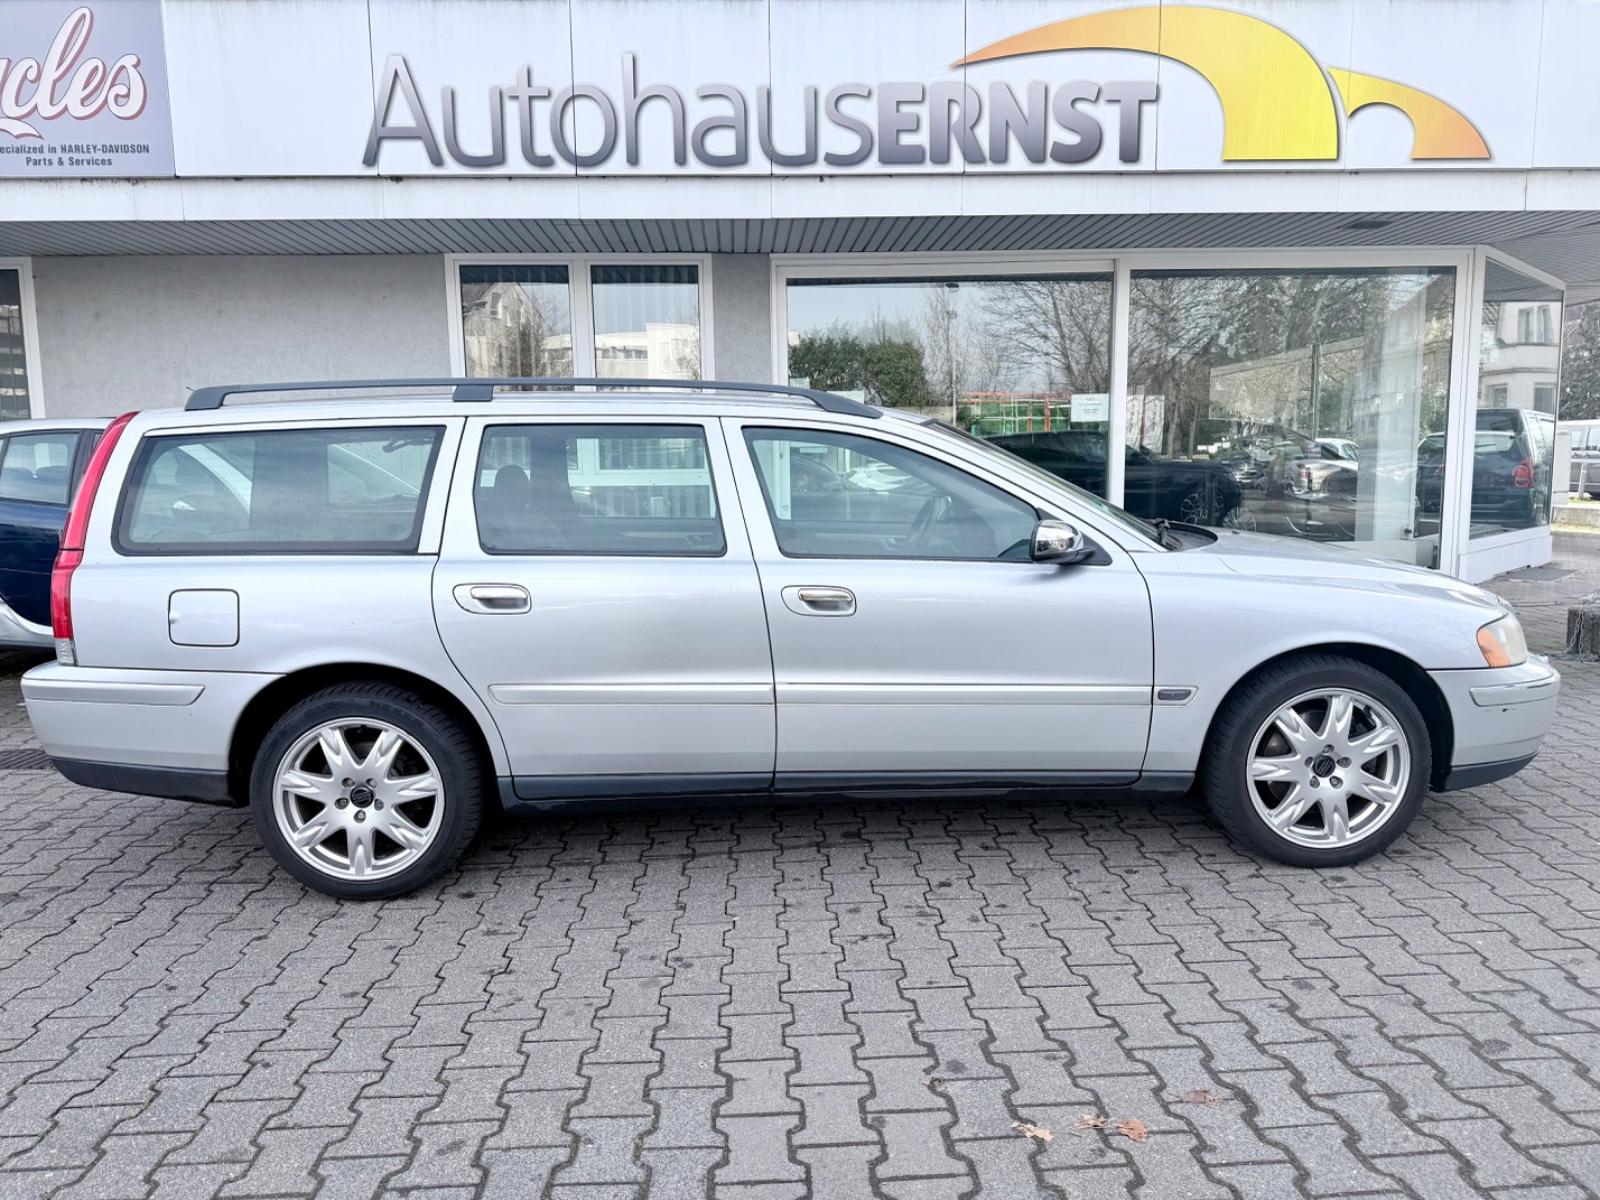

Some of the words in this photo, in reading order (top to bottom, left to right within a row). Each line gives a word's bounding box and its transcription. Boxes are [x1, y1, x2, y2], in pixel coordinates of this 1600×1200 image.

[47, 144, 57, 154] in
[60, 144, 150, 154] HARLEY-DAVIDSON
[26, 156, 54, 166] Parts
[57, 156, 65, 166] &
[68, 156, 113, 166] Services
